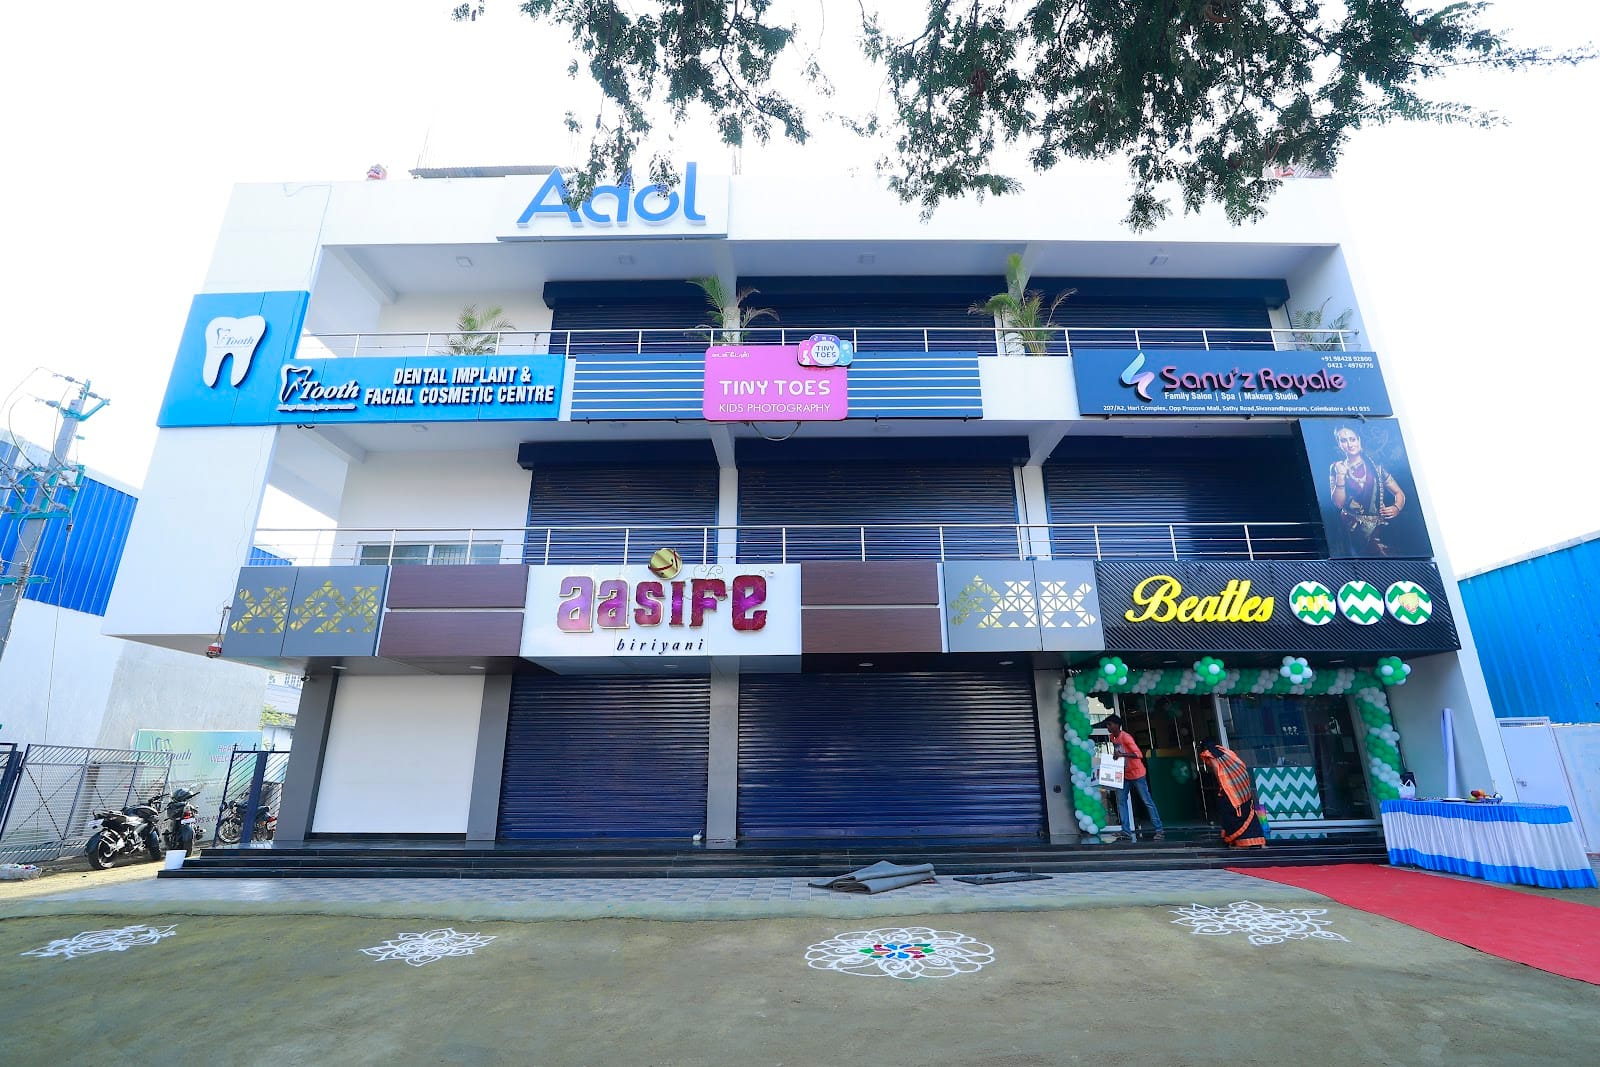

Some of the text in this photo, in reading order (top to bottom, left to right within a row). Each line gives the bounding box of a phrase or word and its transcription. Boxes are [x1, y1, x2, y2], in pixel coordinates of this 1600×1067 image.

[393, 366, 532, 385] DENTAL IMPLANT &
[1258, 367, 1347, 395] Royale
[298, 380, 360, 400] Tooth
[363, 385, 555, 405] FACIAL COSMETIC CENTRE
[719, 380, 831, 395] TINY TOES
[1164, 392, 1190, 401] Family
[1191, 392, 1213, 400] Salon
[1220, 392, 1236, 401] Spa
[1244, 392, 1274, 401] Makeup
[1275, 392, 1299, 400] Studio
[719, 403, 831, 413] KIDS PHOTOGRAPHY
[1124, 574, 1275, 623] Beatles
[617, 638, 704, 654] biriyani
